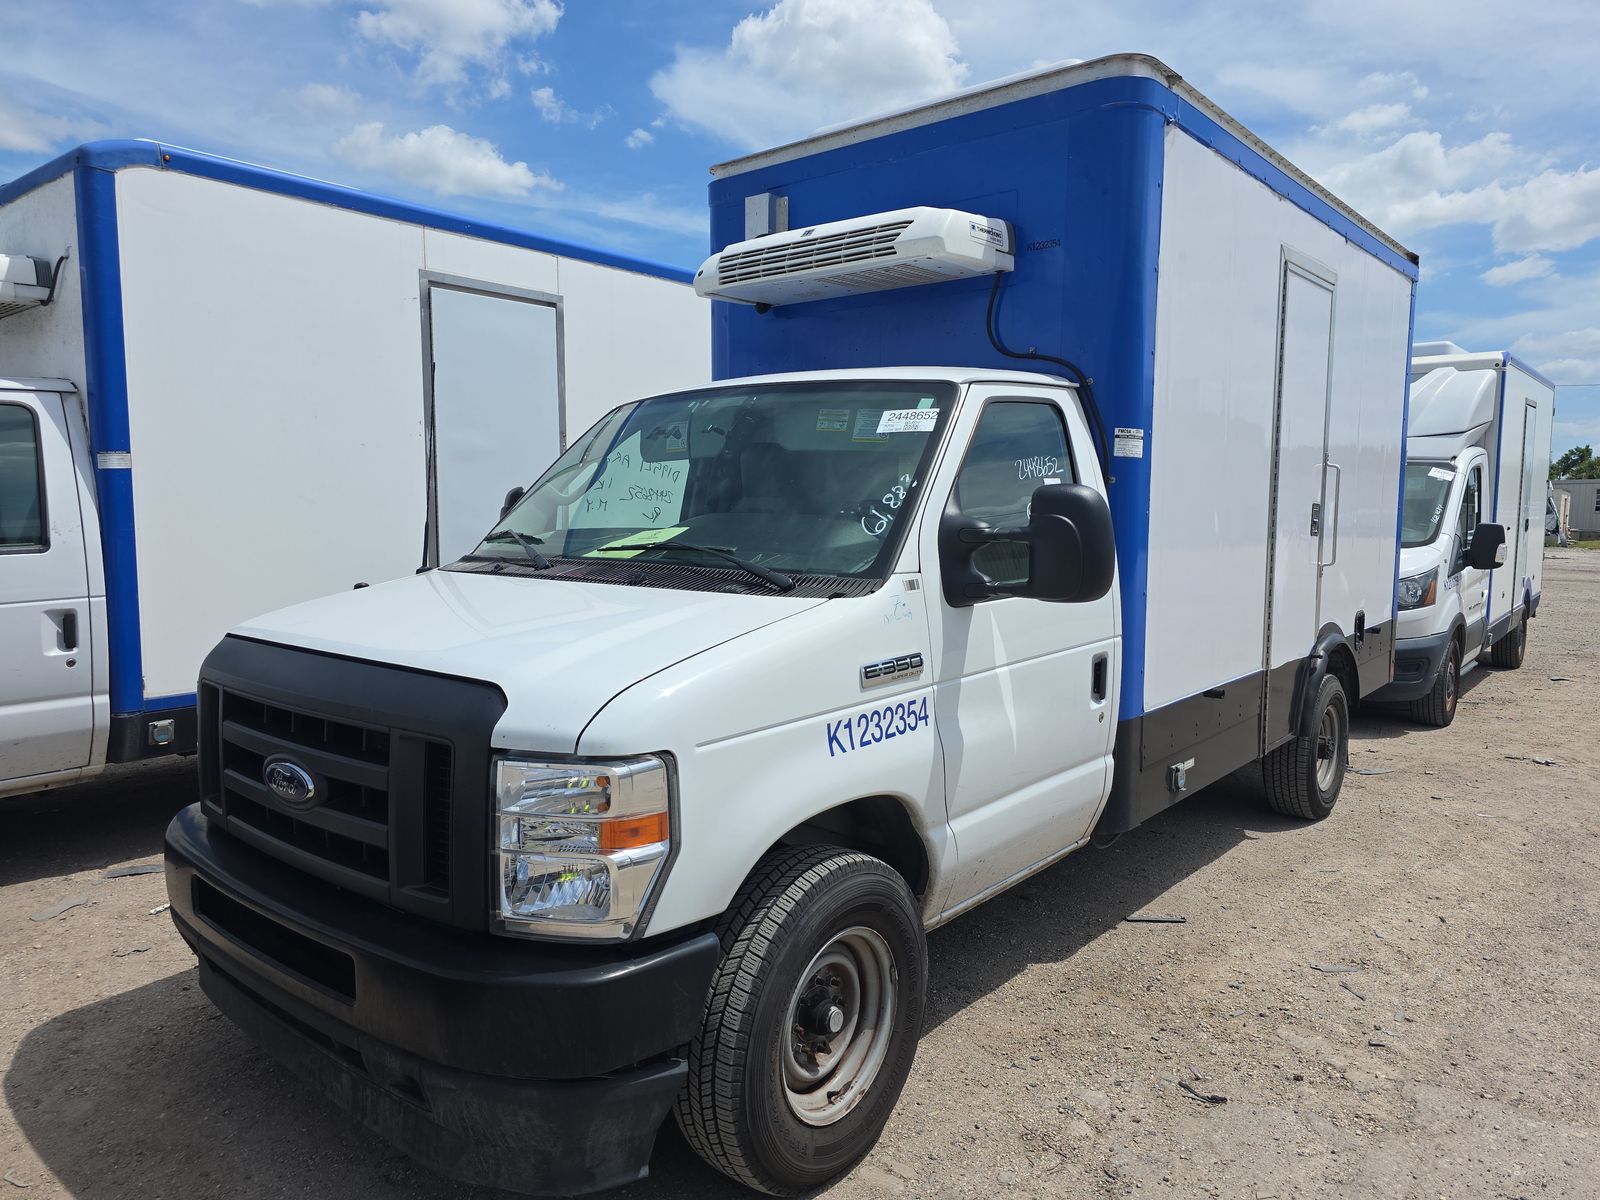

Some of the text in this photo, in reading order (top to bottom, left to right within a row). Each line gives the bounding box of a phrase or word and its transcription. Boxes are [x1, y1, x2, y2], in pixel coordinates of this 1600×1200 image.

[887, 411, 939, 421] 2448652
[1014, 456, 1064, 480] 2448652
[863, 653, 923, 679] E-350
[826, 696, 929, 757] K1232354
[271, 768, 298, 795] Ford
